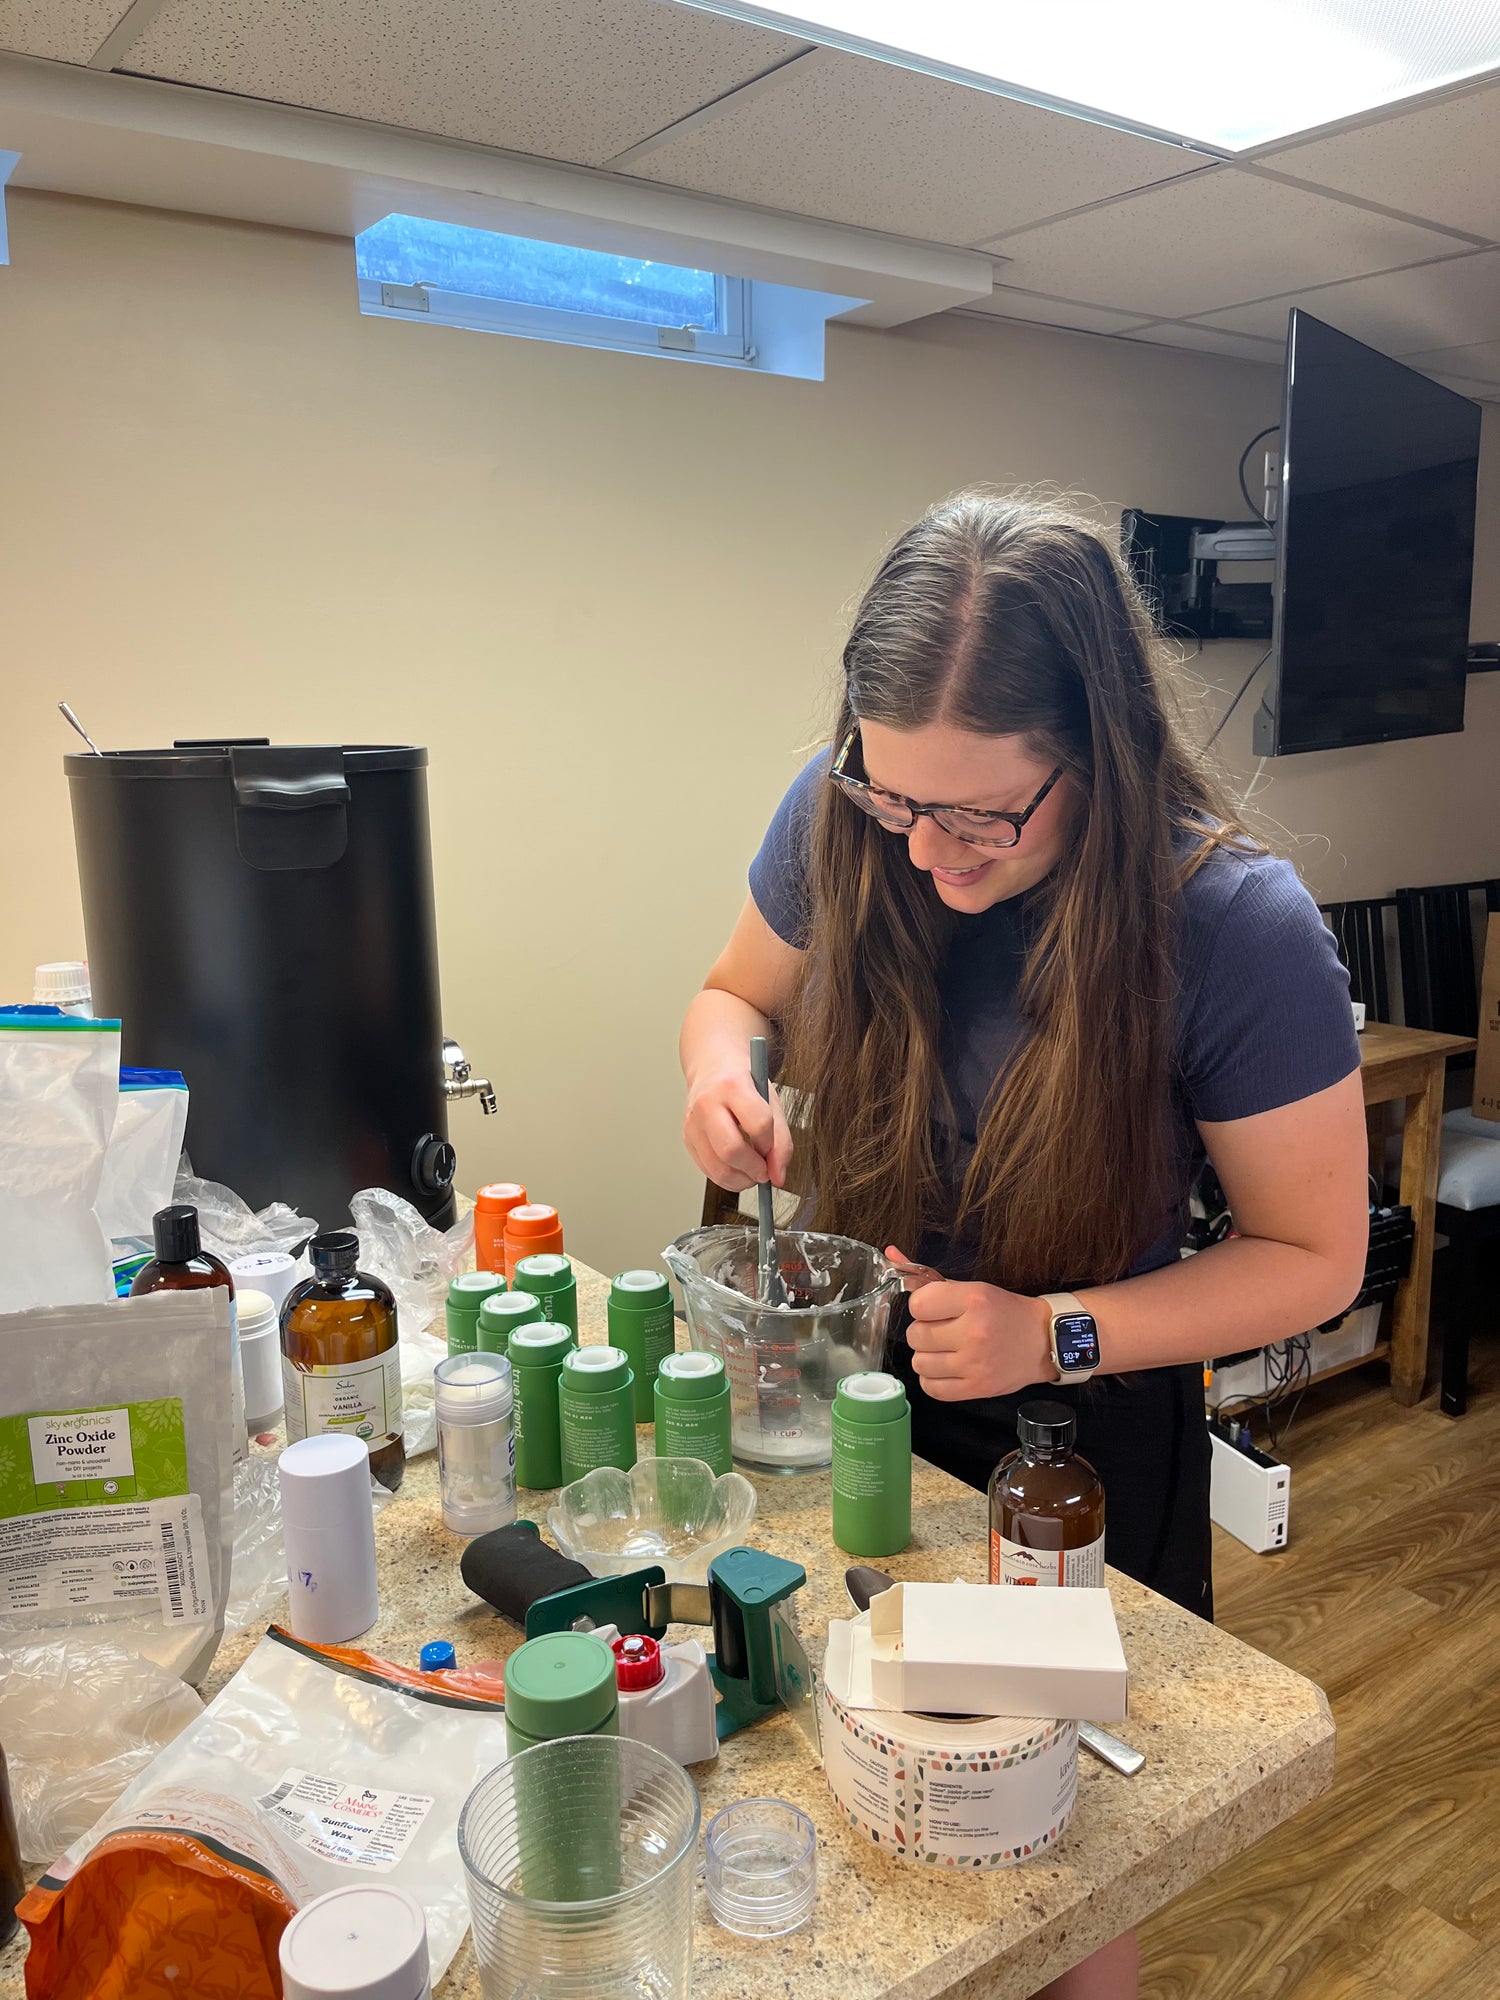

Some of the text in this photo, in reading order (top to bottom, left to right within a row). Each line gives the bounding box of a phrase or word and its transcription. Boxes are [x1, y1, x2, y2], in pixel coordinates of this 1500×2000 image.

[544, 1295, 553, 1320] true
[1062, 1352, 1080, 1360] 4:05
[512, 1368, 521, 1395] true
[335, 1394, 360, 1402] ORGANIC
[333, 1402, 362, 1410] VANILLA
[46, 1420, 61, 1430] sky
[45, 1430, 116, 1444] Zinc Oxide
[780, 1430, 797, 1438] CUP
[57, 1444, 107, 1456] Powder
[1040, 1561, 1056, 1570] herbs
[346, 1796, 378, 1810] MAKING
[276, 1806, 293, 1815] ISO
[321, 1816, 374, 1834] Sunflower
[330, 1829, 353, 1841] Wax
[336, 1846, 354, 1856] 500g
